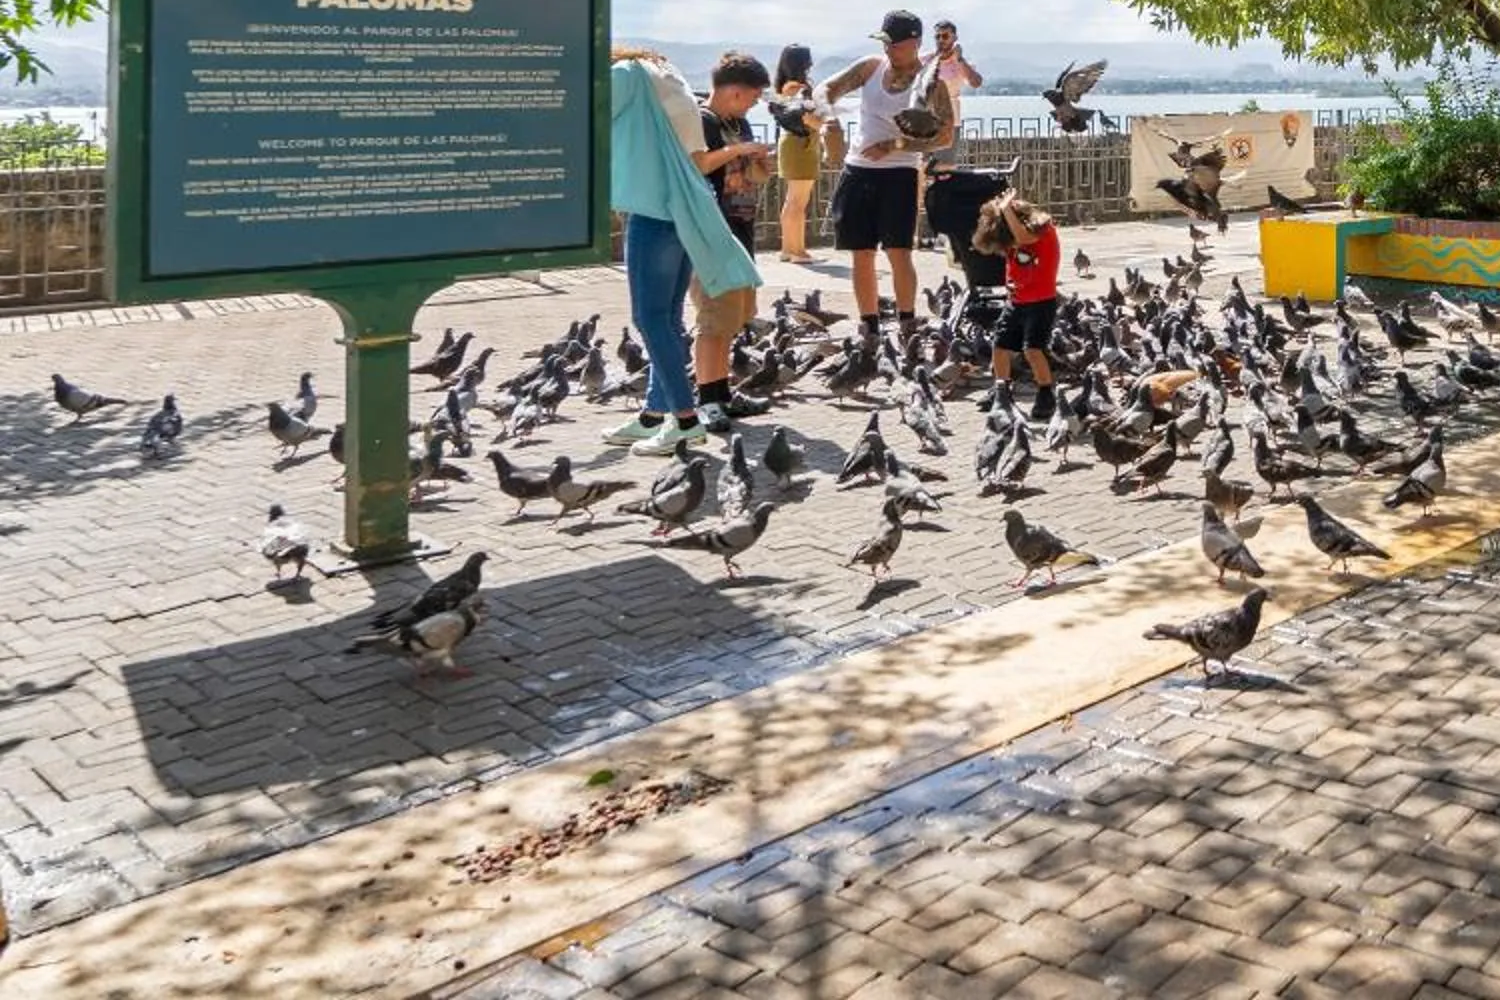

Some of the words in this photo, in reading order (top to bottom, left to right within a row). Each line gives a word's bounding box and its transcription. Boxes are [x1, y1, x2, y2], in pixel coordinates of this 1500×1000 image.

[343, 25, 359, 36] AL
[363, 25, 413, 37] PARQUE
[415, 27, 433, 38] DE
[436, 27, 460, 38] LAS
[258, 138, 323, 149] WELCOME
[329, 137, 347, 148] TO
[350, 136, 400, 148] PARQUE
